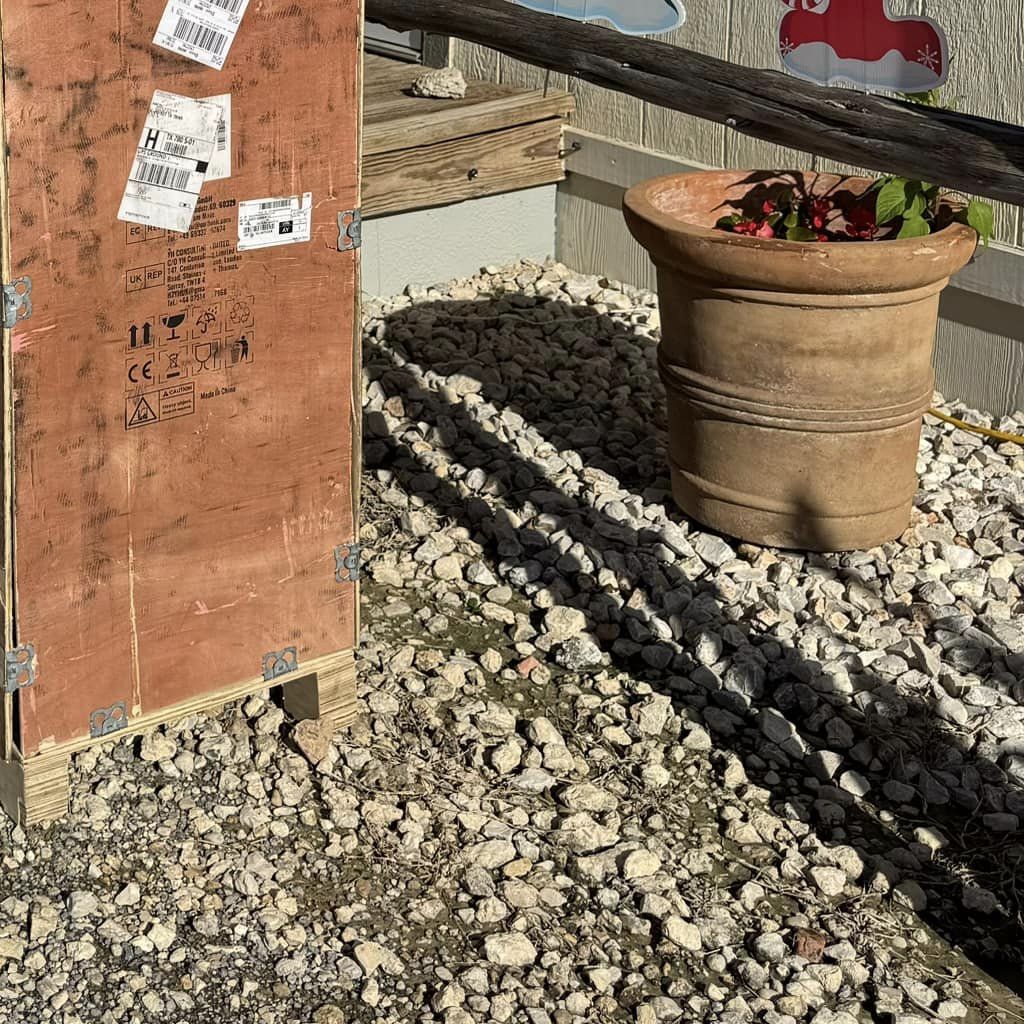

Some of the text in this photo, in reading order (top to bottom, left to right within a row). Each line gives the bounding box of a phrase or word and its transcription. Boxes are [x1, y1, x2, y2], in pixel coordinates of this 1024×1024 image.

[144, 129, 160, 149] H
[130, 227, 141, 236] EC
[129, 270, 163, 284] UK REP
[169, 385, 193, 395] CAUTION
